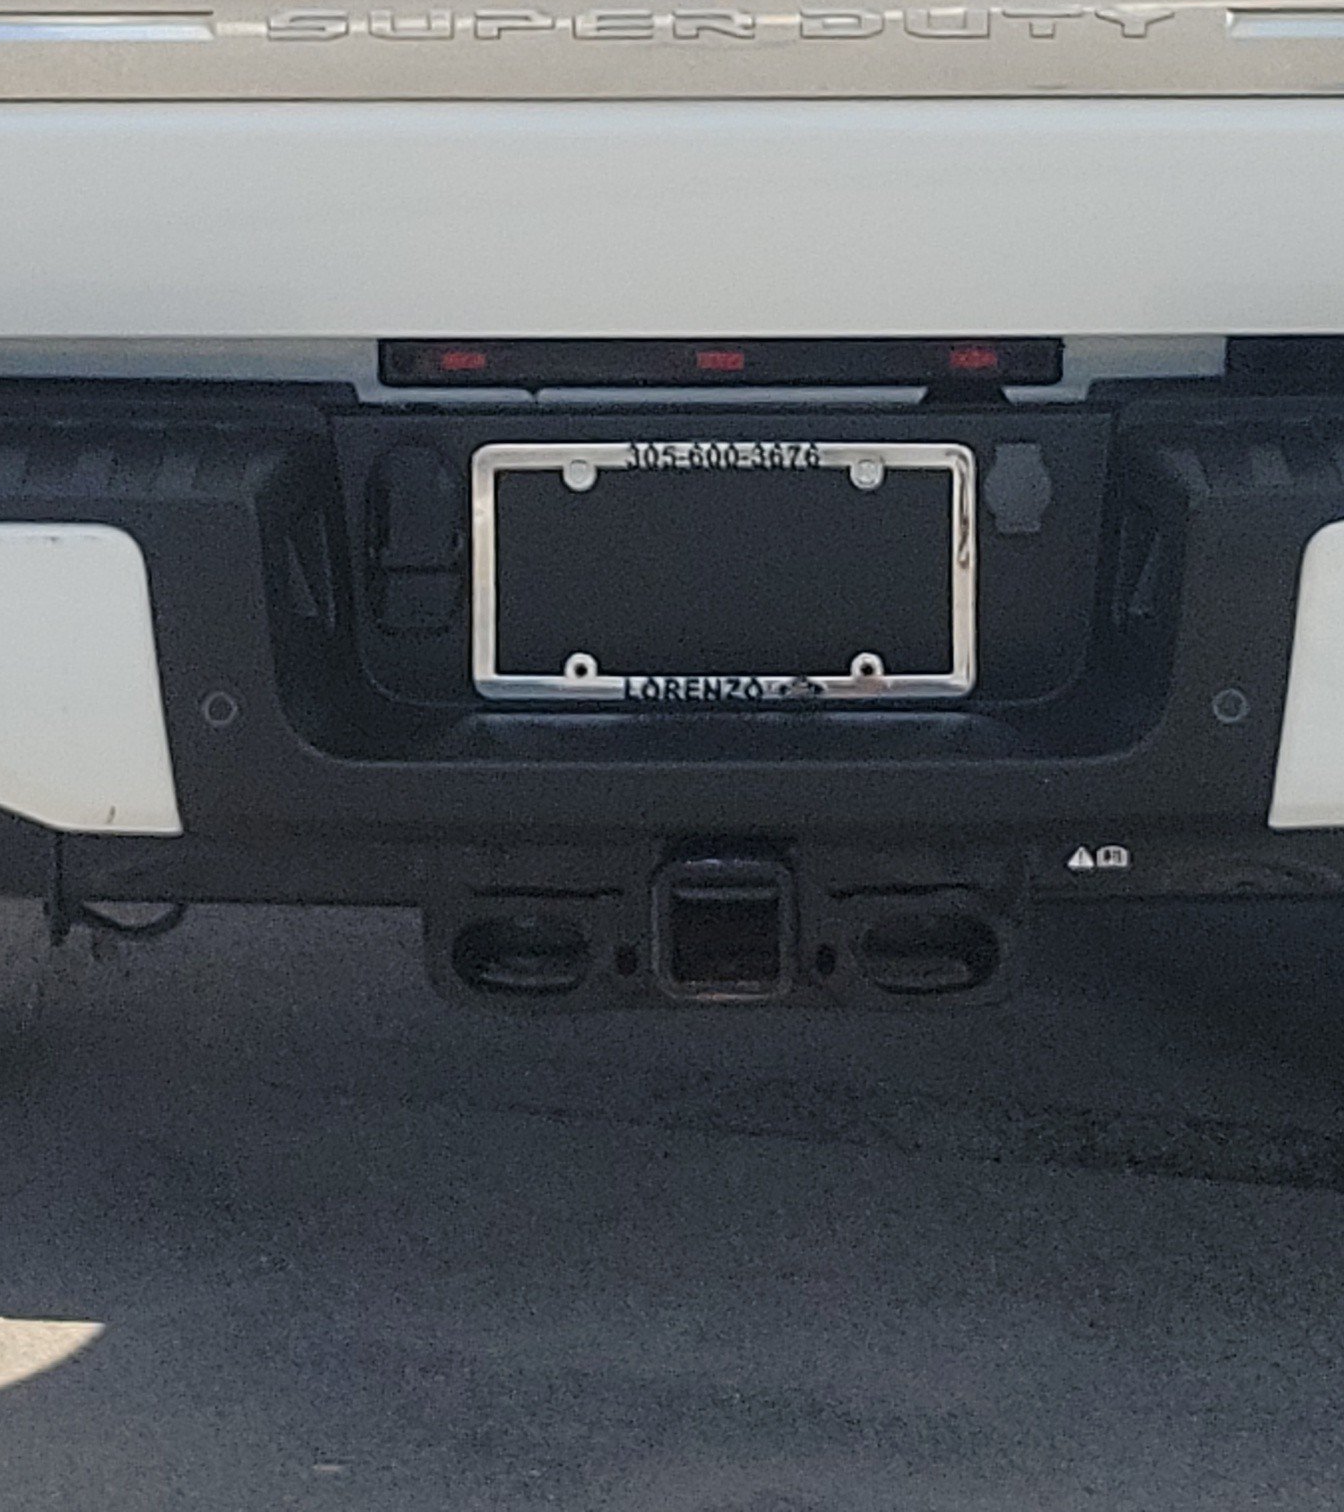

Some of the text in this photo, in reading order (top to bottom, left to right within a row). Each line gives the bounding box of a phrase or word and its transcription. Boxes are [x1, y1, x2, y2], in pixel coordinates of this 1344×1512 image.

[265, 5, 1177, 42] SUPER DUTY
[626, 441, 820, 470] 305-600-3676
[624, 676, 763, 701] LORENZO
